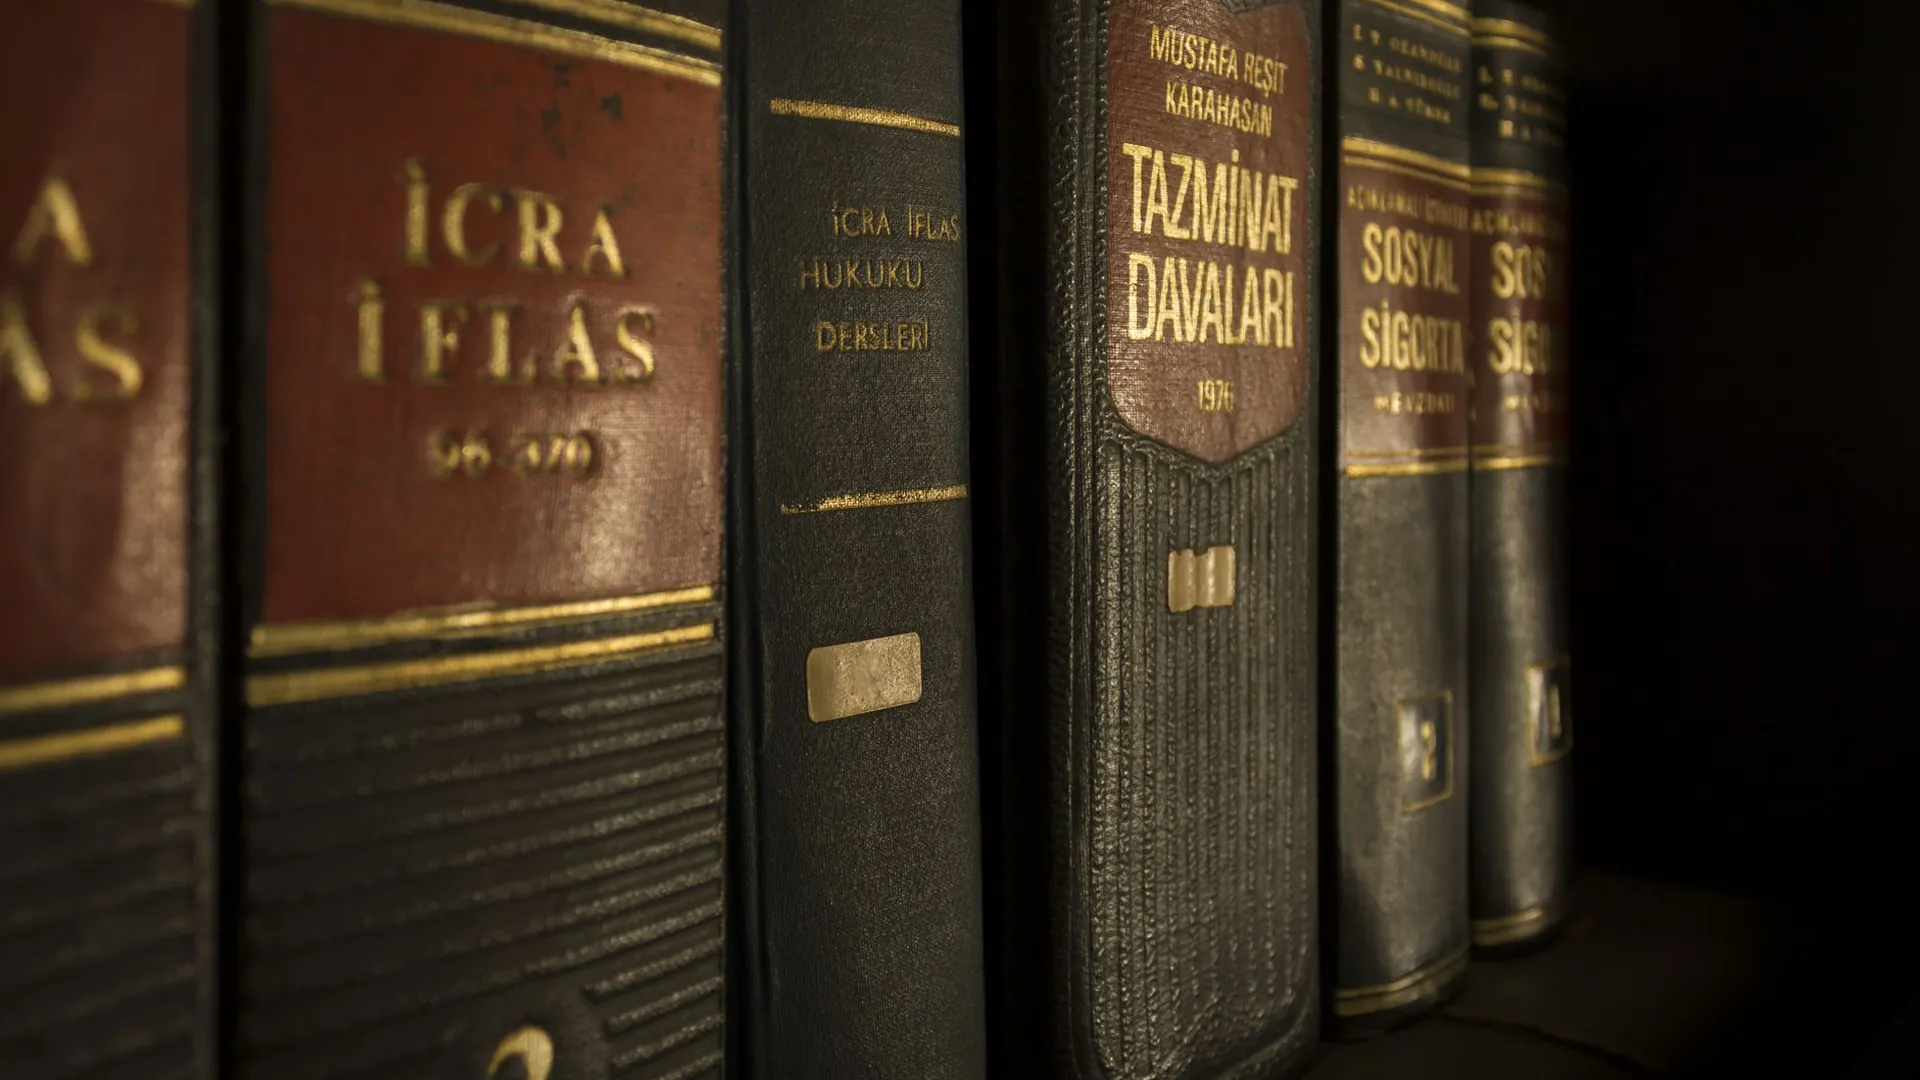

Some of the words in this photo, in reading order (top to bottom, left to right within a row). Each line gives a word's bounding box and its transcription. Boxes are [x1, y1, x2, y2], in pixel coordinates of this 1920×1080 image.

[1151, 24, 1238, 80] MUSTAFA
[1165, 80, 1272, 138] KARAHASAN
[402, 156, 628, 277] İCRA
[1122, 142, 1298, 254] TAZMİNAT
[801, 259, 923, 289] HUKUKU
[1362, 221, 1460, 294] SOSYAL
[1128, 252, 1294, 349] DAVALARI
[1359, 297, 1465, 375] SİGORTA
[1197, 378, 1236, 413] 1976
